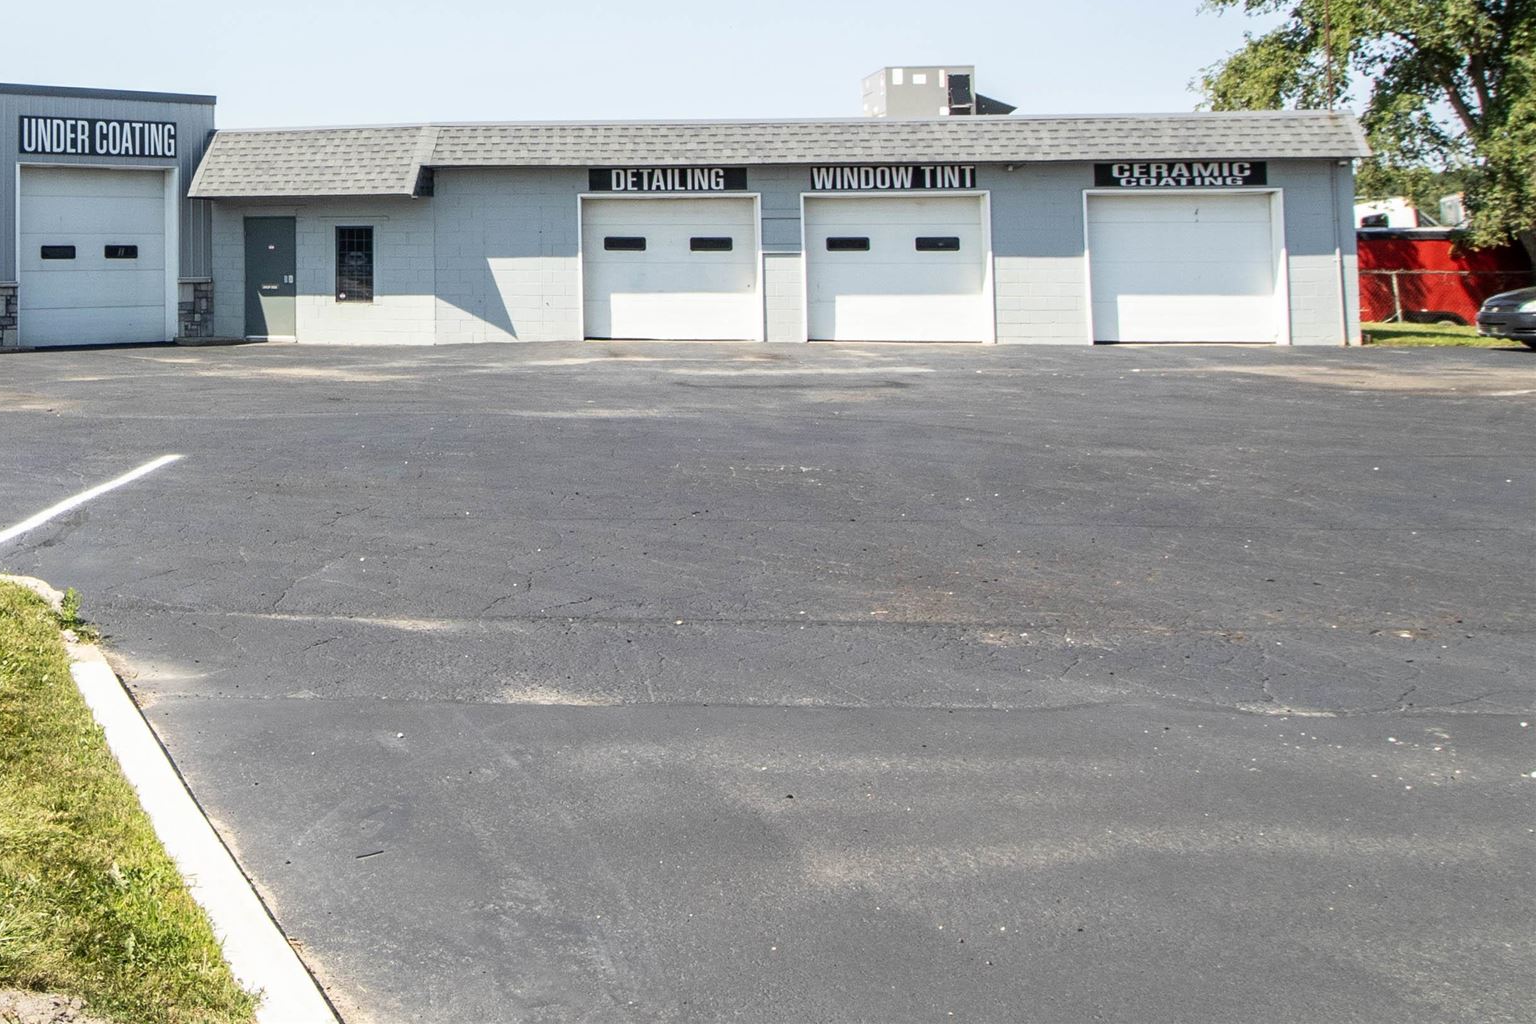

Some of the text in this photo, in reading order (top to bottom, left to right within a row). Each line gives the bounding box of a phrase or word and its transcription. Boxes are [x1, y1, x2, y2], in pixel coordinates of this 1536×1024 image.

[23, 117, 175, 157] UNDER COATING
[611, 168, 725, 191] DETAILING
[812, 165, 975, 190] WINDOW TINT
[1111, 162, 1252, 178] CERAMIC
[1119, 176, 1244, 187] COATING
